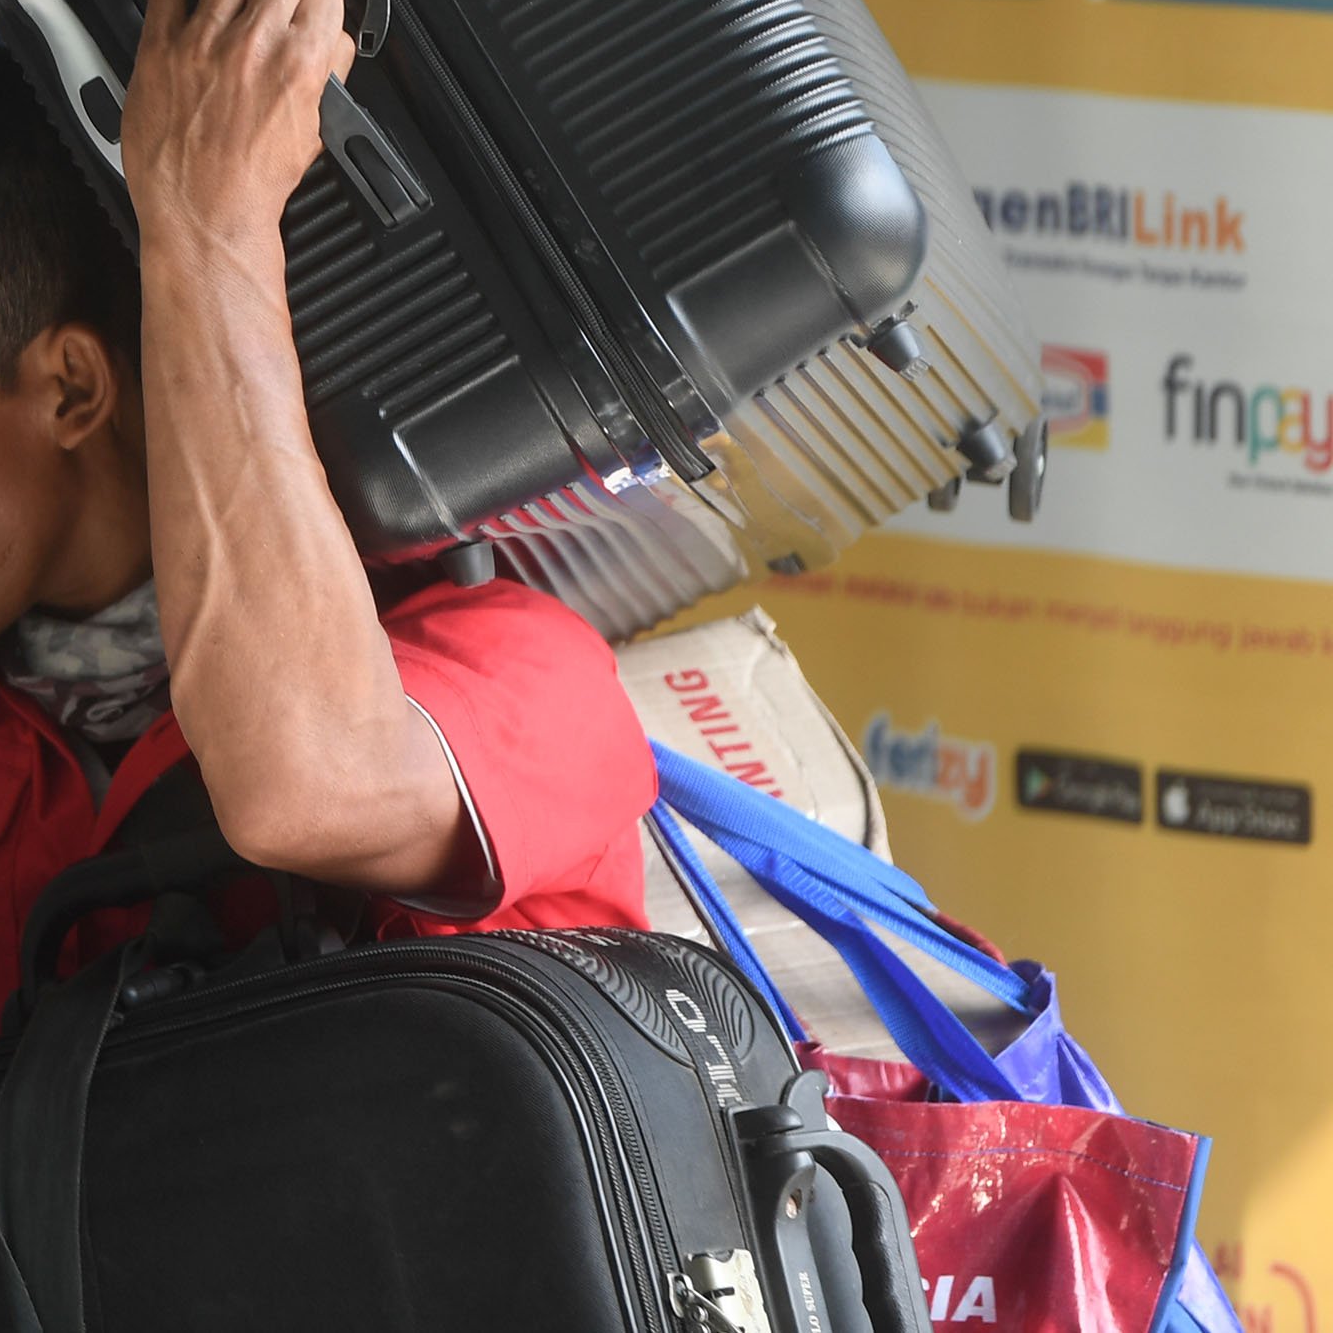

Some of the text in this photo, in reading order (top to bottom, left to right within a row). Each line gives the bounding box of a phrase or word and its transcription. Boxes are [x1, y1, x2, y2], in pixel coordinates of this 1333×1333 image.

[1161, 351, 1333, 474] finpay
[664, 669, 784, 798] NTING
[867, 713, 989, 810] ferizy
[798, 1271, 817, 1312] SUPER
[921, 1275, 997, 1323] IA
